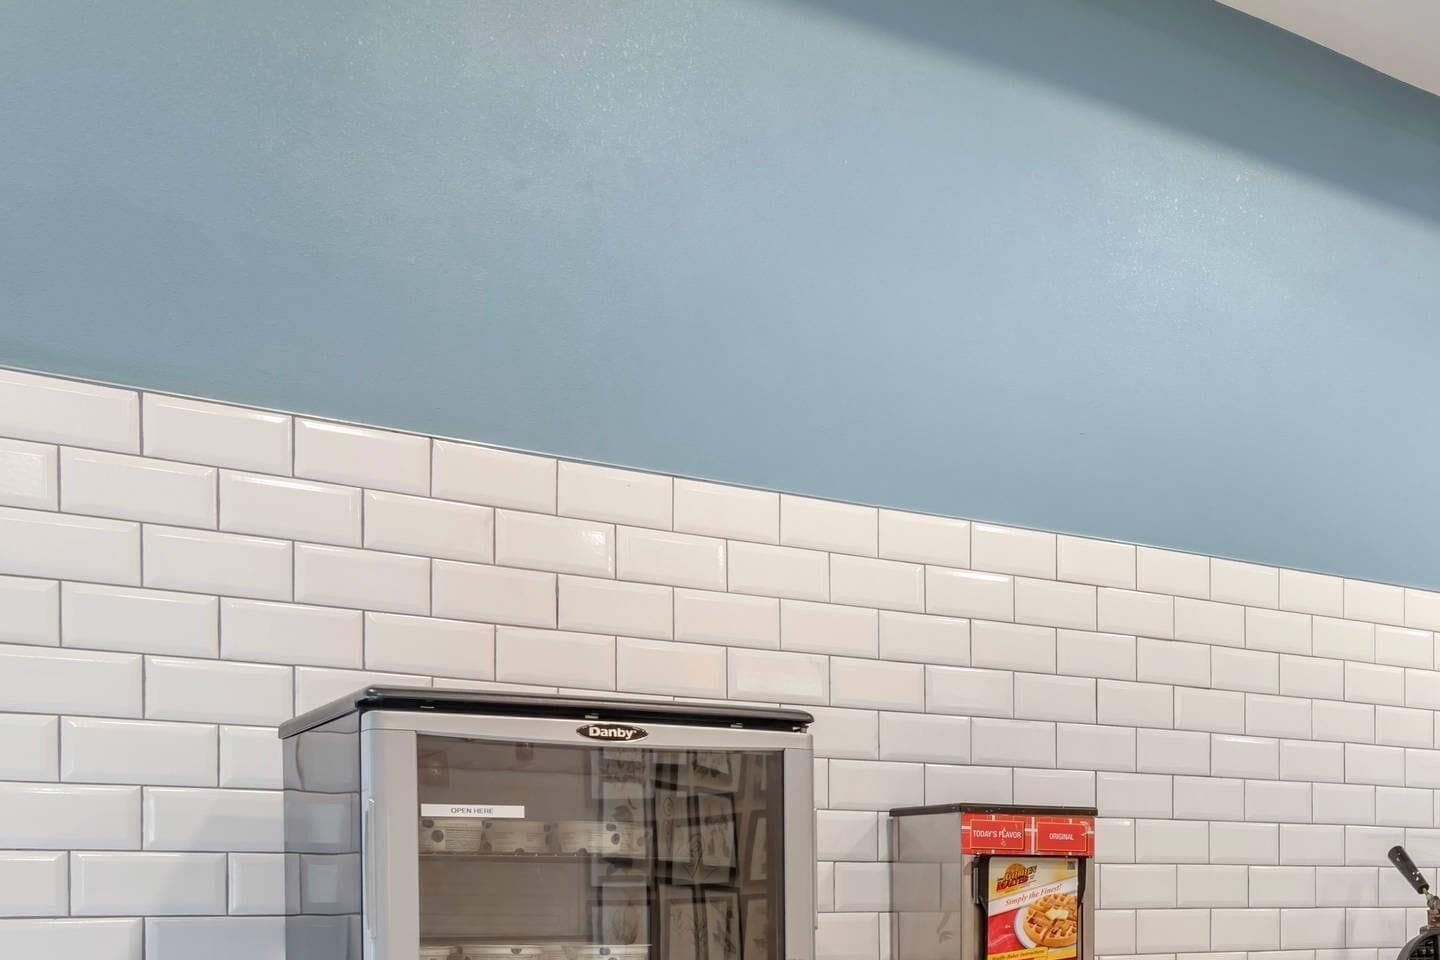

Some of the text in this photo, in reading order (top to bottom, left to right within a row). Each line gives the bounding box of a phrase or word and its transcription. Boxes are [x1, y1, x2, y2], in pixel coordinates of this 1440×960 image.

[588, 726, 634, 740] Danby
[473, 807, 493, 815] HERE
[973, 829, 1022, 840] TODAY'S FLAVOR
[1048, 832, 1075, 841] ORIGINAL
[1006, 893, 1028, 906] Simply
[1029, 890, 1040, 899] the
